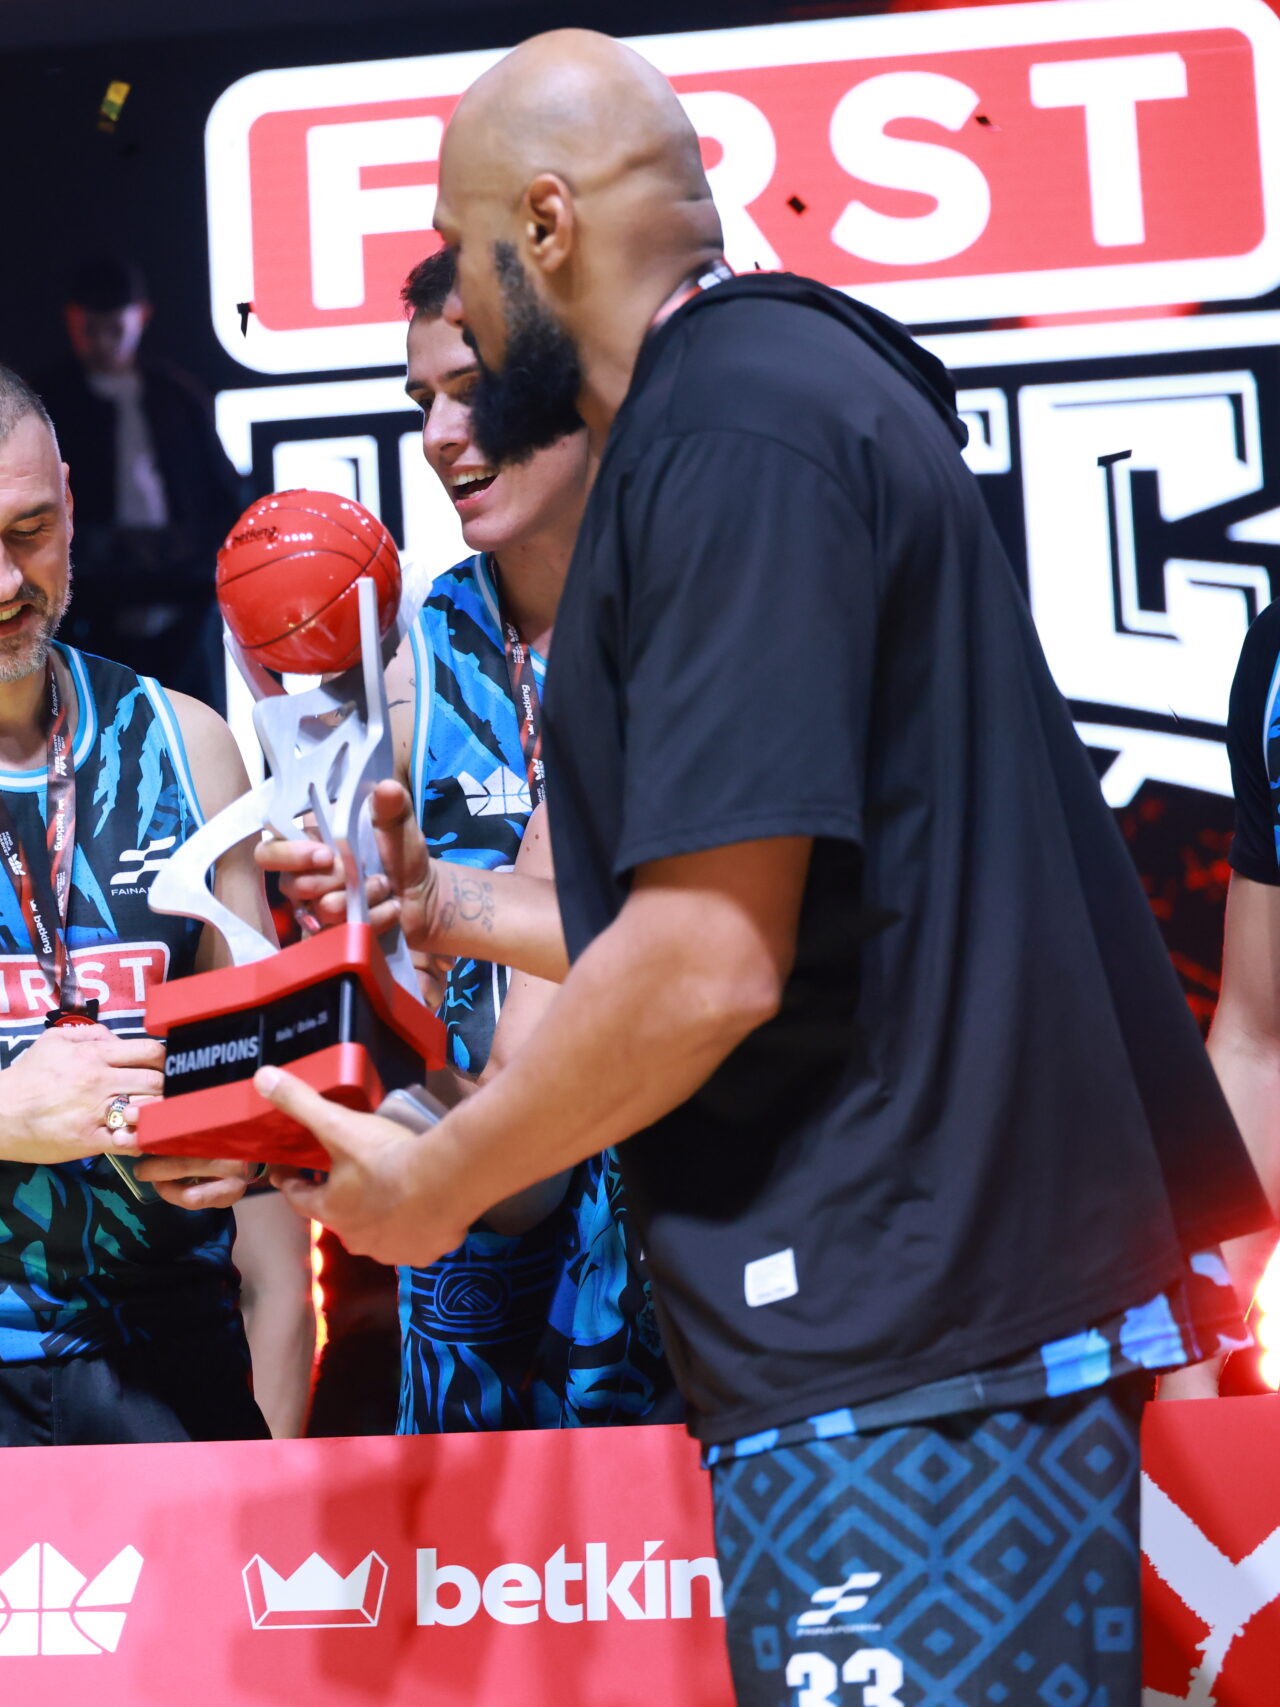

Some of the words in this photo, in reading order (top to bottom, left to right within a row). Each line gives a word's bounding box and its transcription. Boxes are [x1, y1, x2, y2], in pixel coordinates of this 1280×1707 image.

[522, 684, 534, 720] betking
[111, 887, 147, 897] FAINA
[33, 914, 53, 954] betking
[165, 1036, 259, 1077] CHAMPIONS
[416, 1540, 726, 1627] betkin
[785, 1648, 905, 1707] 33
